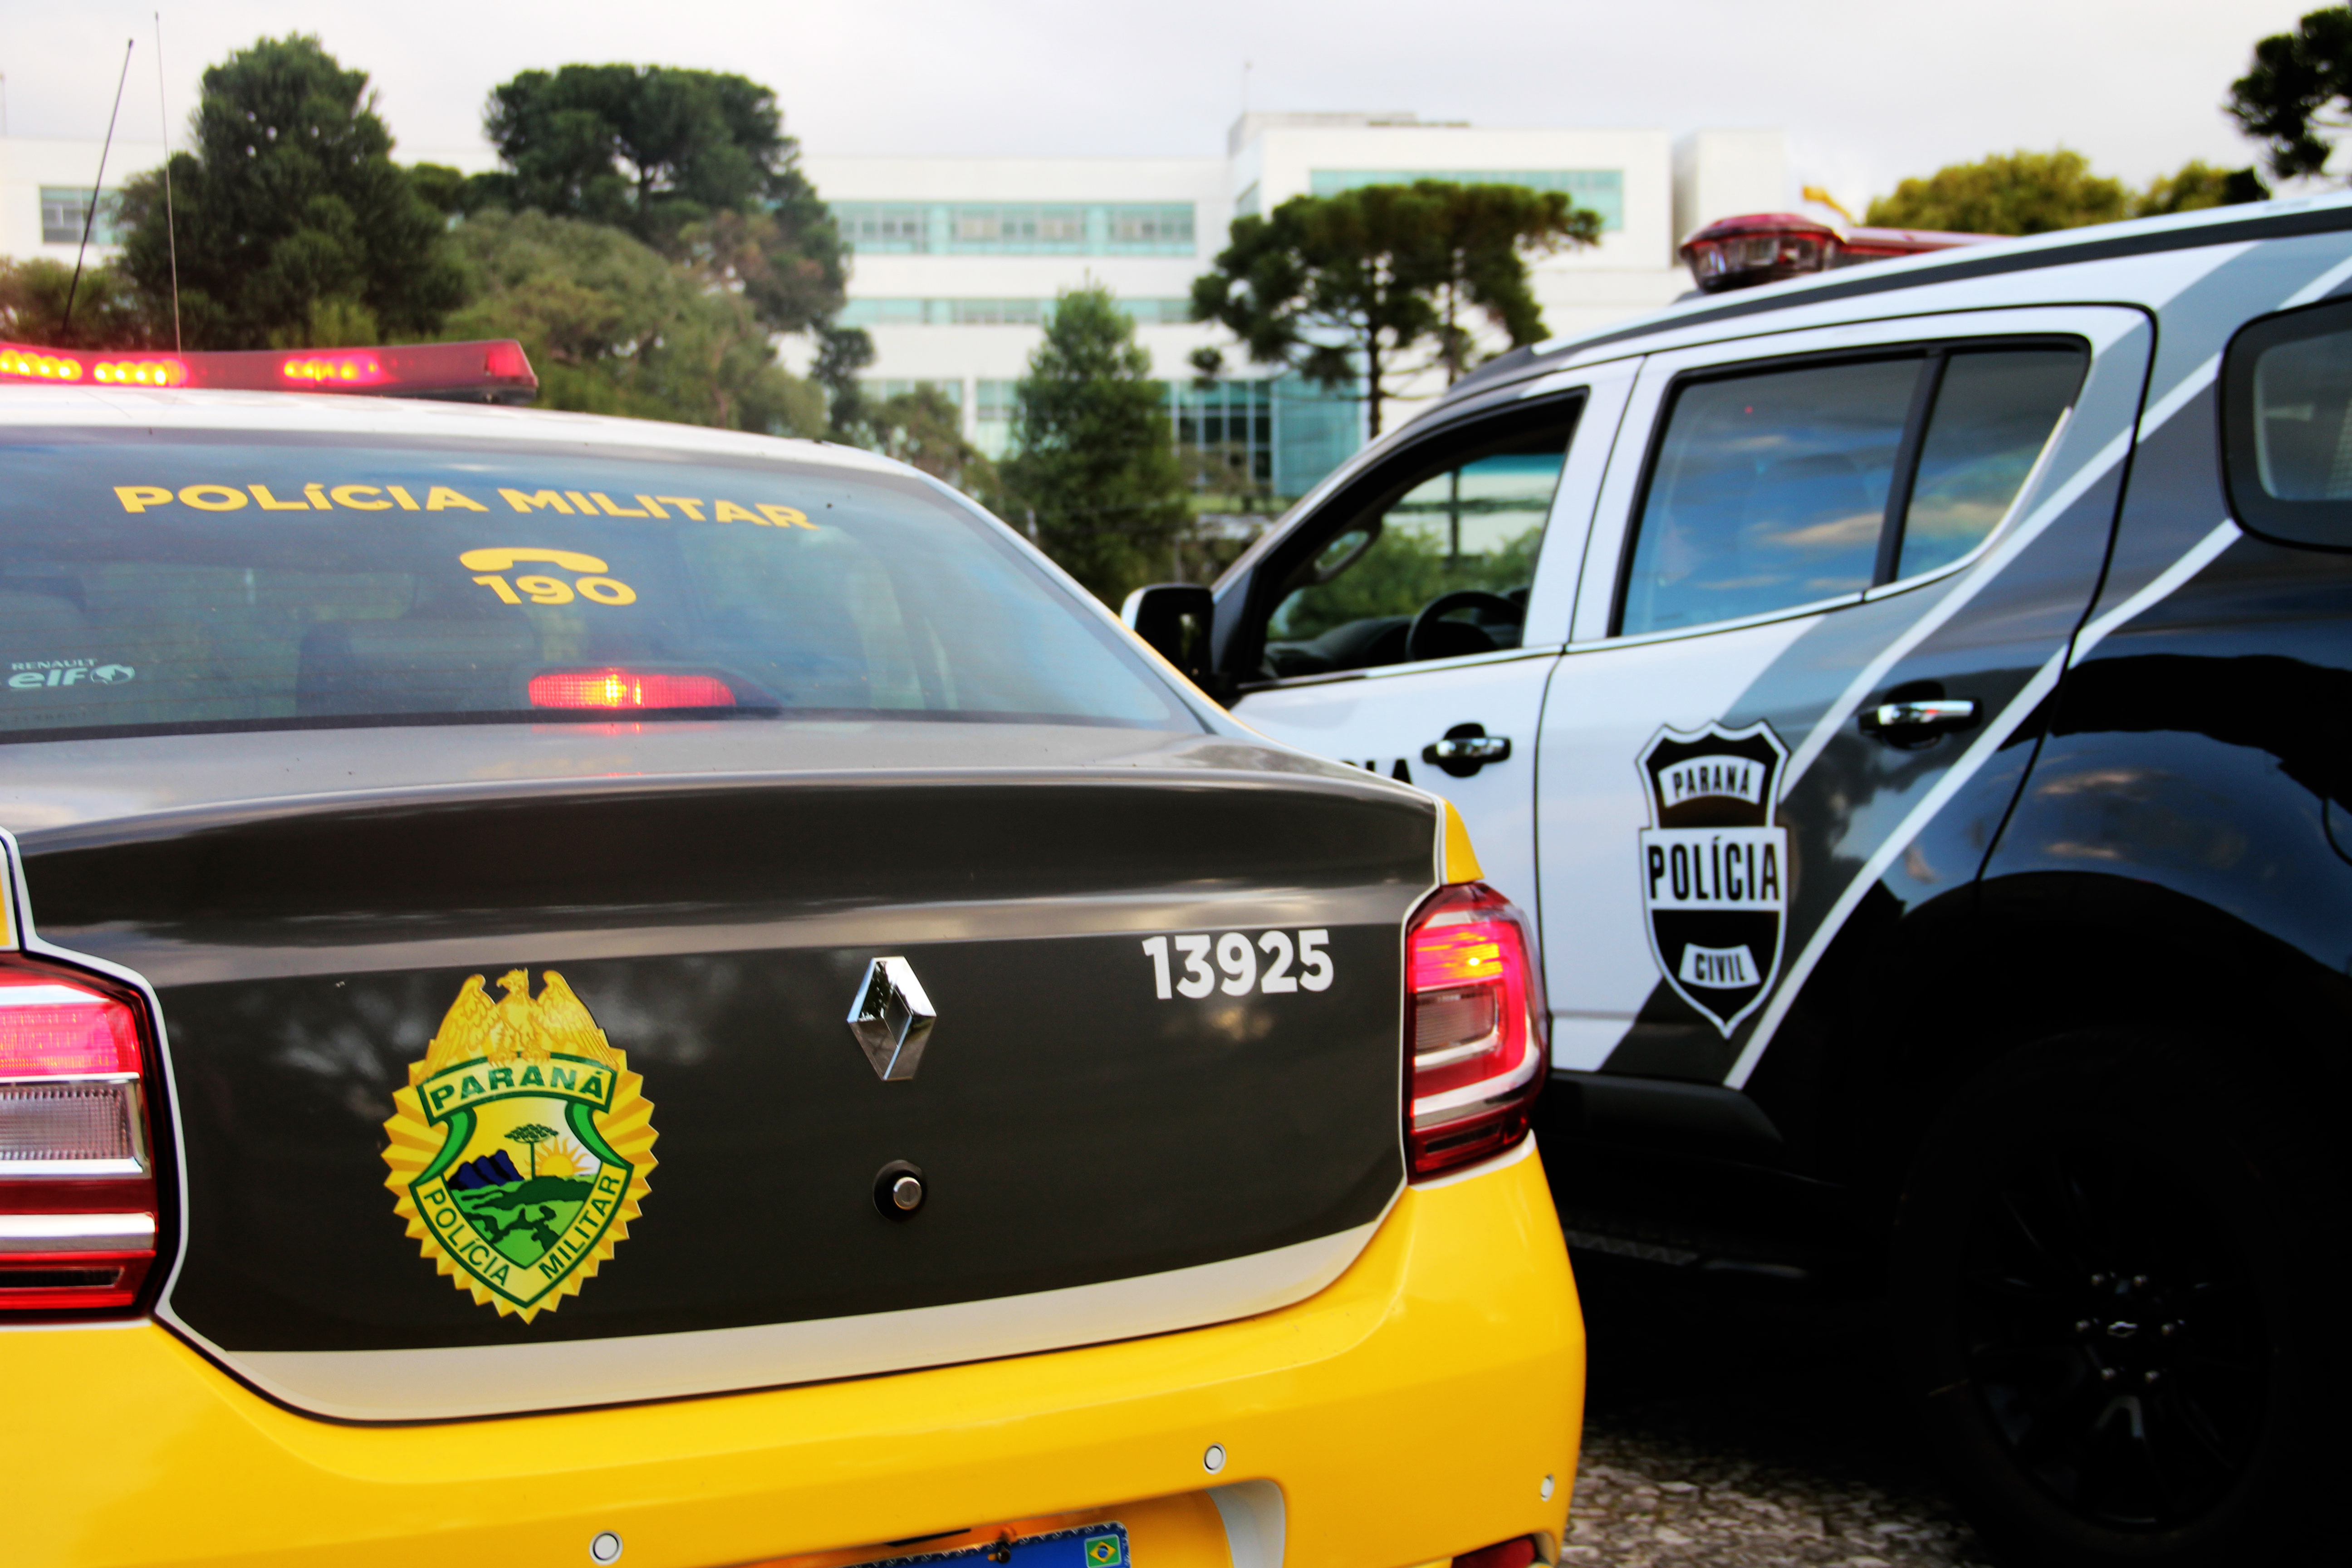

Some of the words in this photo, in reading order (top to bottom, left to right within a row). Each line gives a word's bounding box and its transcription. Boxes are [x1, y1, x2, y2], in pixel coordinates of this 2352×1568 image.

[113, 483, 490, 513] POLÍCIA
[497, 488, 819, 530] MILITAR
[472, 575, 637, 606] 190
[11, 658, 98, 670] RENAULT
[1672, 762, 1751, 799] PARANÁ
[1647, 835, 1780, 901] POLÍCIA
[1142, 929, 1334, 999] 13925
[1694, 953, 1747, 982] CIVIL
[430, 1065, 604, 1111] PARANÁ
[424, 1188, 510, 1286] POLÍCIA
[538, 1174, 620, 1281] MILITAR
